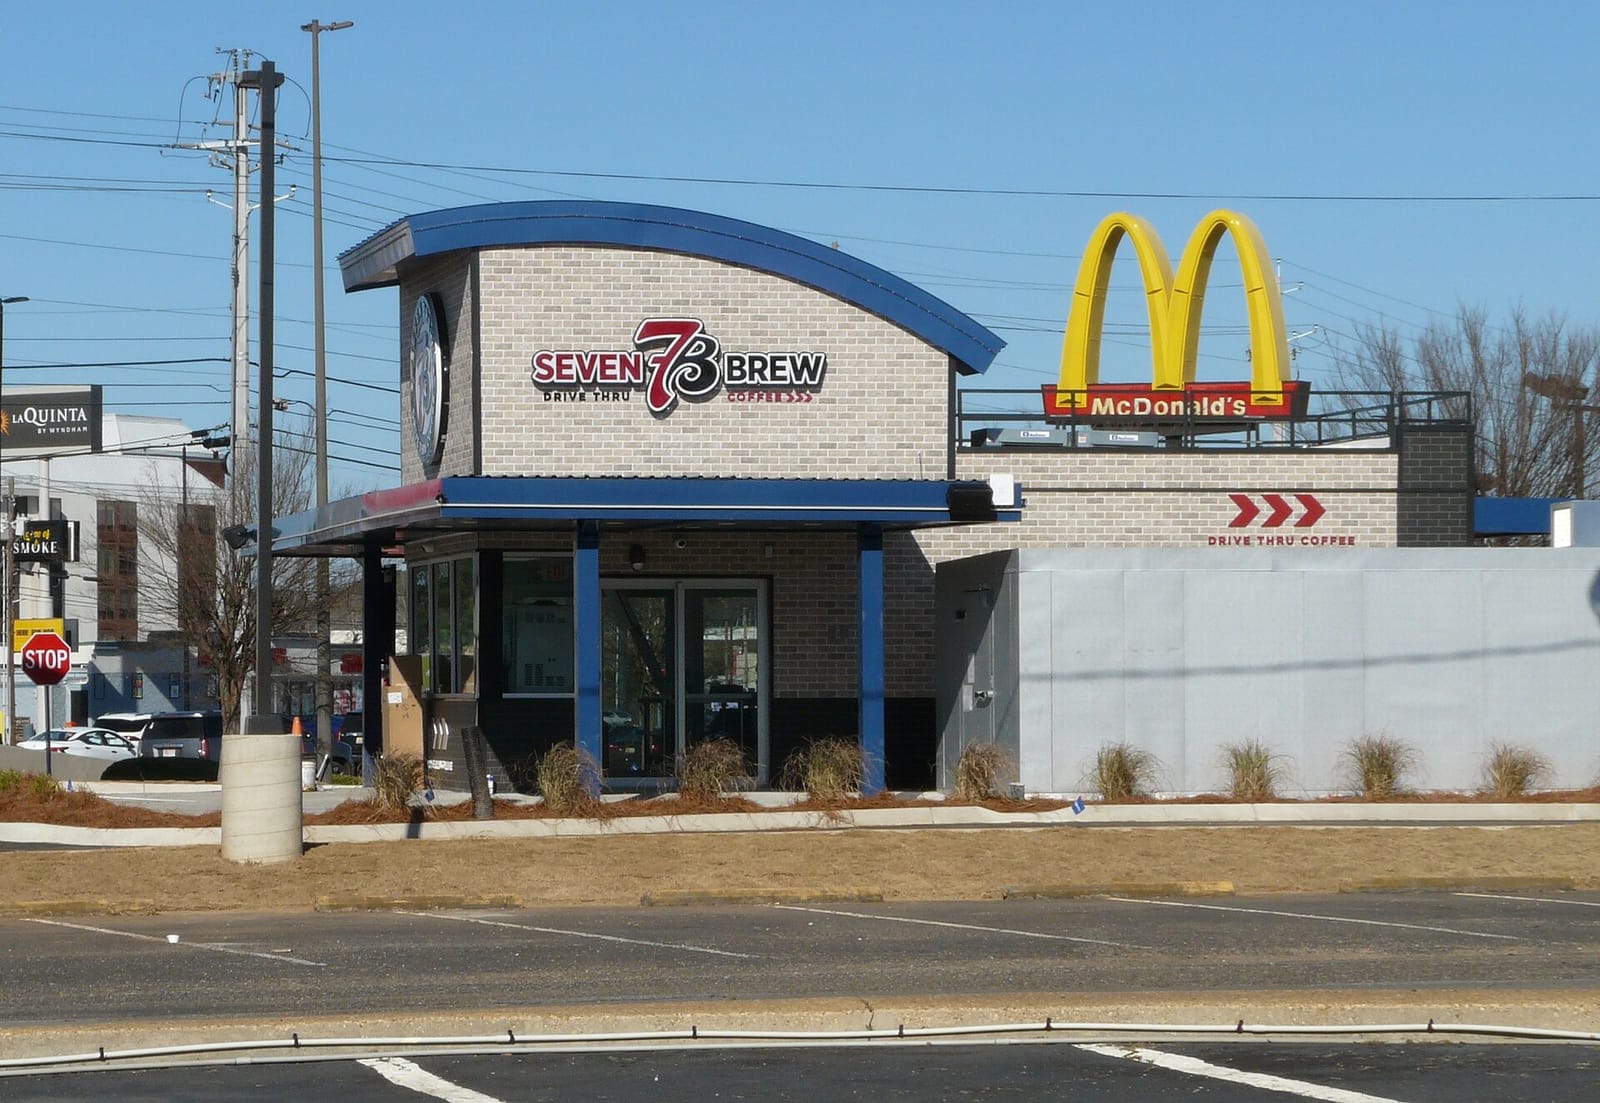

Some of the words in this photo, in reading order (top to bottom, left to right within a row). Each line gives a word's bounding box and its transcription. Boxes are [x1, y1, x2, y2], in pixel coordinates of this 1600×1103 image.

[532, 351, 644, 386] SEVEN
[723, 351, 827, 388] BREW
[543, 392, 585, 402] DRIVE
[593, 392, 630, 402] THRU
[727, 391, 782, 403] COFFEE
[1091, 397, 1247, 416] McDonald's
[23, 407, 88, 427] QUINTA
[13, 541, 58, 554] SMOKE
[1208, 536, 1251, 545] DRIVE
[1257, 536, 1295, 545] THRU
[1301, 536, 1356, 545] COFFEE
[25, 649, 68, 669] STOP
